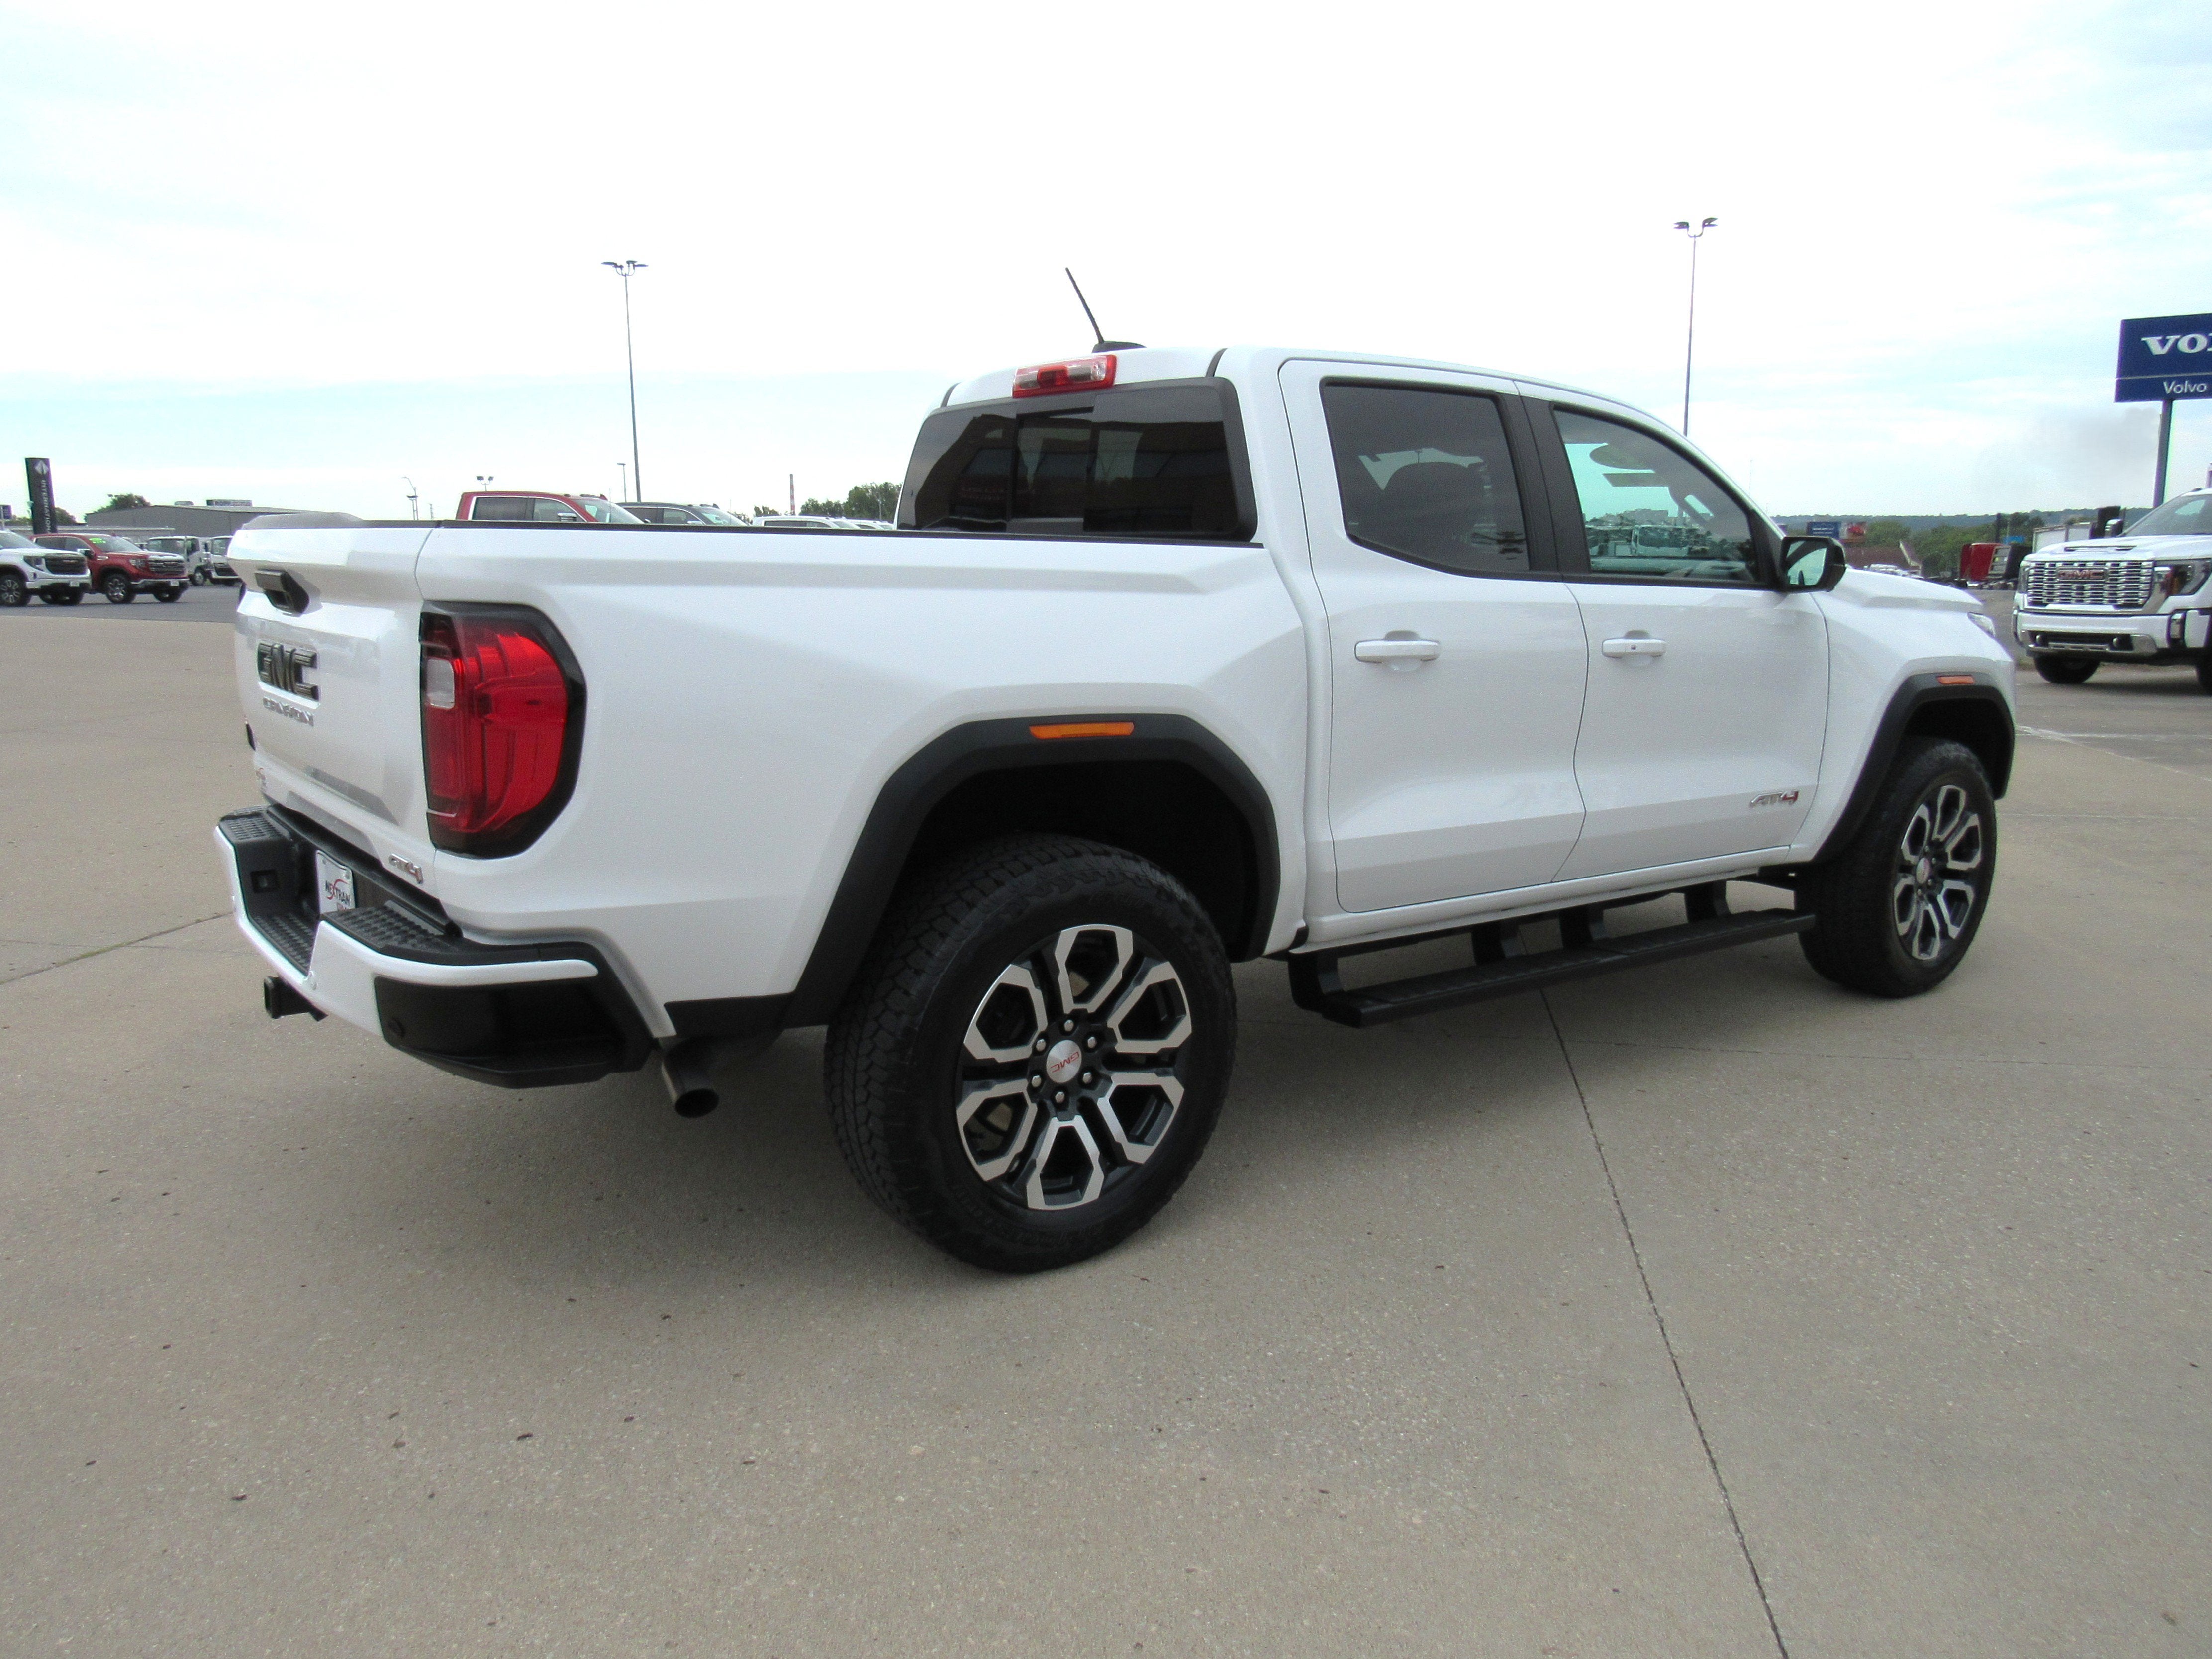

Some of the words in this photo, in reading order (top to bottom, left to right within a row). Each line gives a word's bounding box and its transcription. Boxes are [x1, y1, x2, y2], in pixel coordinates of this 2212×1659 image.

[2163, 380, 2207, 394] Volvo
[2058, 569, 2105, 579] GMC
[257, 643, 319, 701] GMC
[263, 696, 314, 726] CANYON
[1749, 789, 1799, 807] AT4
[389, 853, 423, 884] AT4
[1050, 1051, 1079, 1073] GMC
